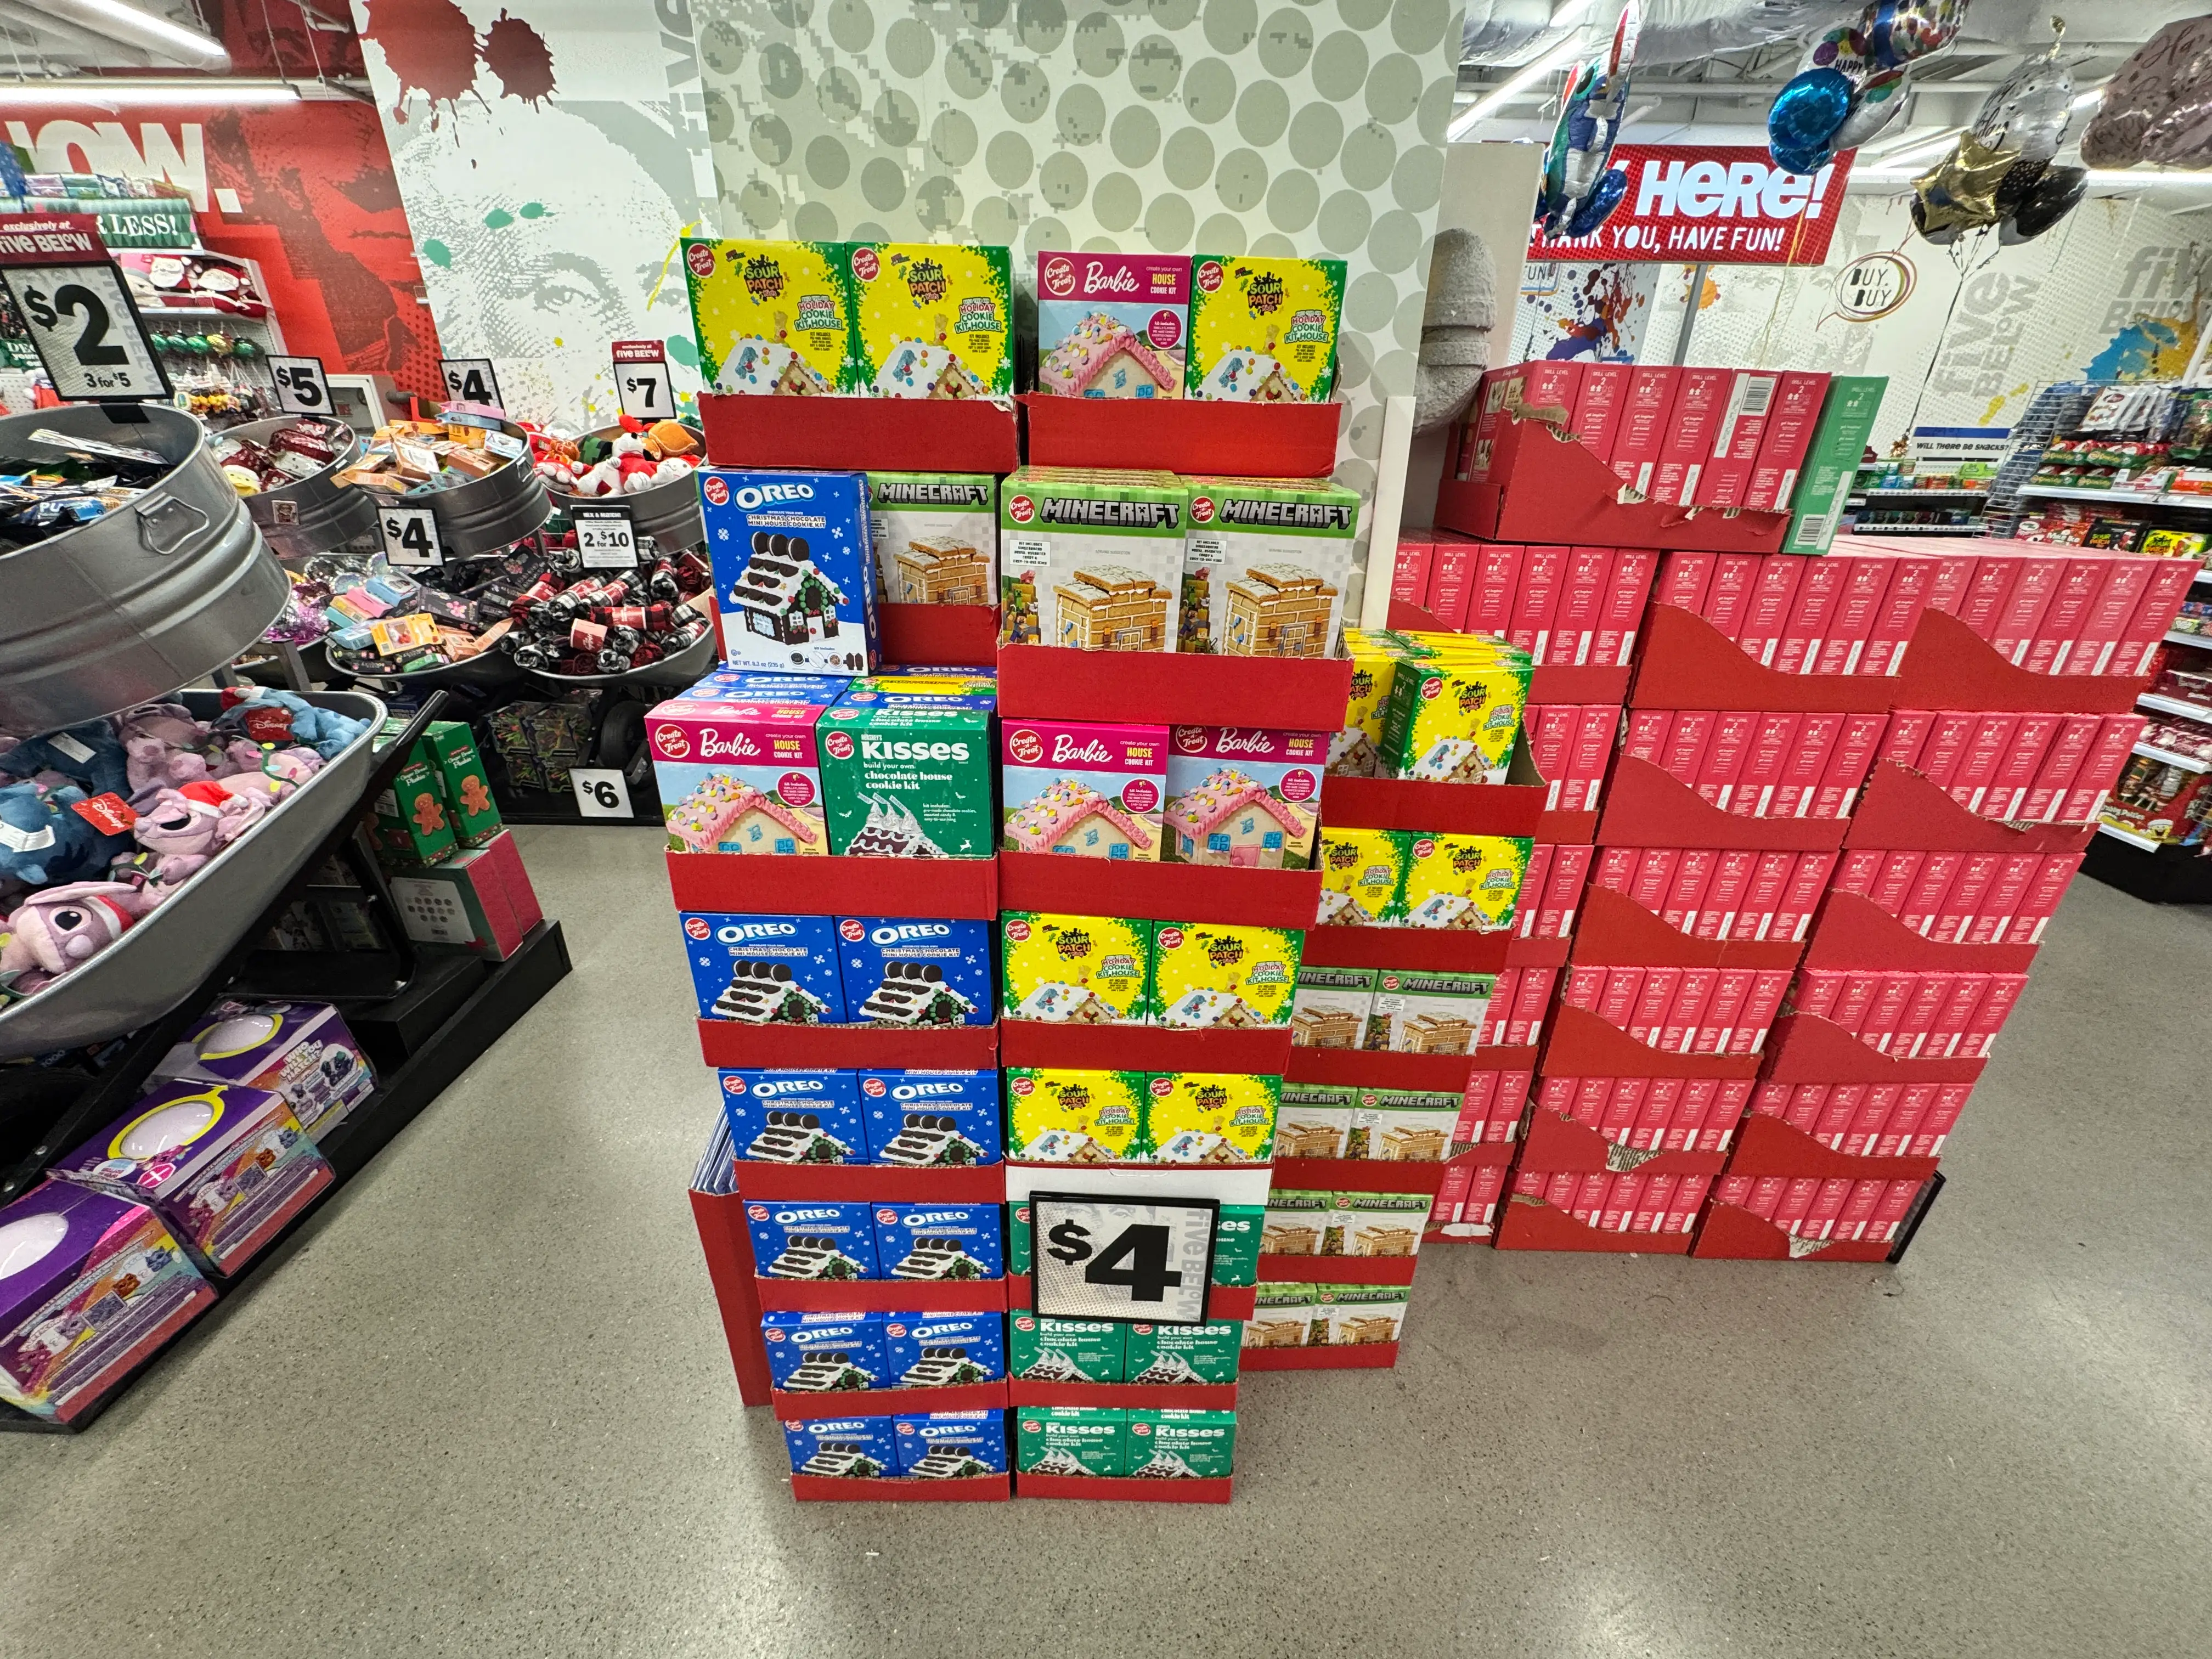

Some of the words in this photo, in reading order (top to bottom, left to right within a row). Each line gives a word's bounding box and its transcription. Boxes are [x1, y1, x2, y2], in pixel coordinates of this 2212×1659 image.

[1835, 59, 1863, 73] HAPPY
[3, 221, 57, 232] exclusively
[109, 213, 178, 237] LESS!
[32, 233, 92, 252] BELOW
[1613, 225, 1661, 253] YOU,
[1668, 226, 1730, 251] HAVE
[1730, 227, 1785, 252] FUN!
[745, 266, 780, 279] SOUR
[909, 269, 943, 282] SOUR
[1047, 264, 1070, 277] Create
[1052, 275, 1071, 290] Treat
[1084, 261, 1139, 294] Barbie
[1152, 273, 1176, 285] HOUSE
[747, 278, 783, 291] PATCH
[910, 281, 946, 295] PATCH
[1250, 283, 1282, 295] SOUR
[1249, 295, 1283, 306] PATCH
[1854, 289, 1892, 307] BUY
[798, 301, 834, 311] HOLIDAY
[801, 311, 833, 320] COOKIE
[1292, 315, 1325, 324] HOLIDAY
[24, 284, 130, 365] $2
[795, 320, 811, 330] KIT
[812, 319, 841, 329] HOUSE
[1292, 324, 1322, 333] COOKIE
[1285, 333, 1299, 343] KIT
[1299, 332, 1328, 341] HOUSE
[83, 373, 97, 388] 3
[98, 374, 114, 387] for
[113, 372, 131, 387] $5
[1552, 375, 1558, 383] 2
[276, 366, 323, 407] $5
[448, 369, 493, 405] $4
[627, 377, 657, 408] $7
[736, 483, 814, 510] OREO
[878, 483, 988, 505] MINECRAFT
[1011, 499, 1030, 510] Create
[1015, 509, 1032, 520] Treat
[1040, 497, 1180, 529] MINECRAFT
[1219, 498, 1353, 530] MINECRAFT
[387, 517, 433, 558] $4
[584, 532, 595, 547] 2
[1462, 689, 1486, 698] SOUR
[1459, 697, 1486, 708] PATCH
[250, 718, 288, 731] Disney
[658, 730, 681, 741] Create
[827, 736, 848, 746] Create
[1216, 727, 1274, 753] Barbie
[664, 741, 686, 753] Treat
[699, 728, 761, 757] Barbie
[774, 740, 800, 751] HOUSE
[1052, 734, 1113, 763] Barbie
[1289, 738, 1313, 748] HOUSE
[833, 744, 850, 755] Treat
[1127, 747, 1152, 758] HOUSE
[883, 763, 899, 771] your
[865, 771, 918, 780] chocolate
[919, 771, 953, 781] house
[866, 781, 902, 789] cookie
[904, 781, 920, 790] kit
[582, 780, 619, 809] $6
[92, 799, 126, 828] Disney
[718, 923, 796, 943] OREO
[872, 923, 951, 944] OREO
[1058, 934, 1090, 944] SOUR
[1058, 944, 1091, 952] PATCH
[1210, 942, 1242, 952] SOUR
[1209, 950, 1244, 960] PATCH
[1402, 978, 1489, 994] MINECRAFT
[890, 1083, 963, 1100] OREO
[1381, 1096, 1459, 1108] MINECRAFT
[1353, 1199, 1427, 1210] MINECRAFT
[1047, 1219, 1182, 1302] $4
[1336, 1291, 1405, 1304] MINECRAFT
[791, 1327, 854, 1343] OREO
[911, 1323, 973, 1338] OREO
[919, 1425, 977, 1437] OREO
